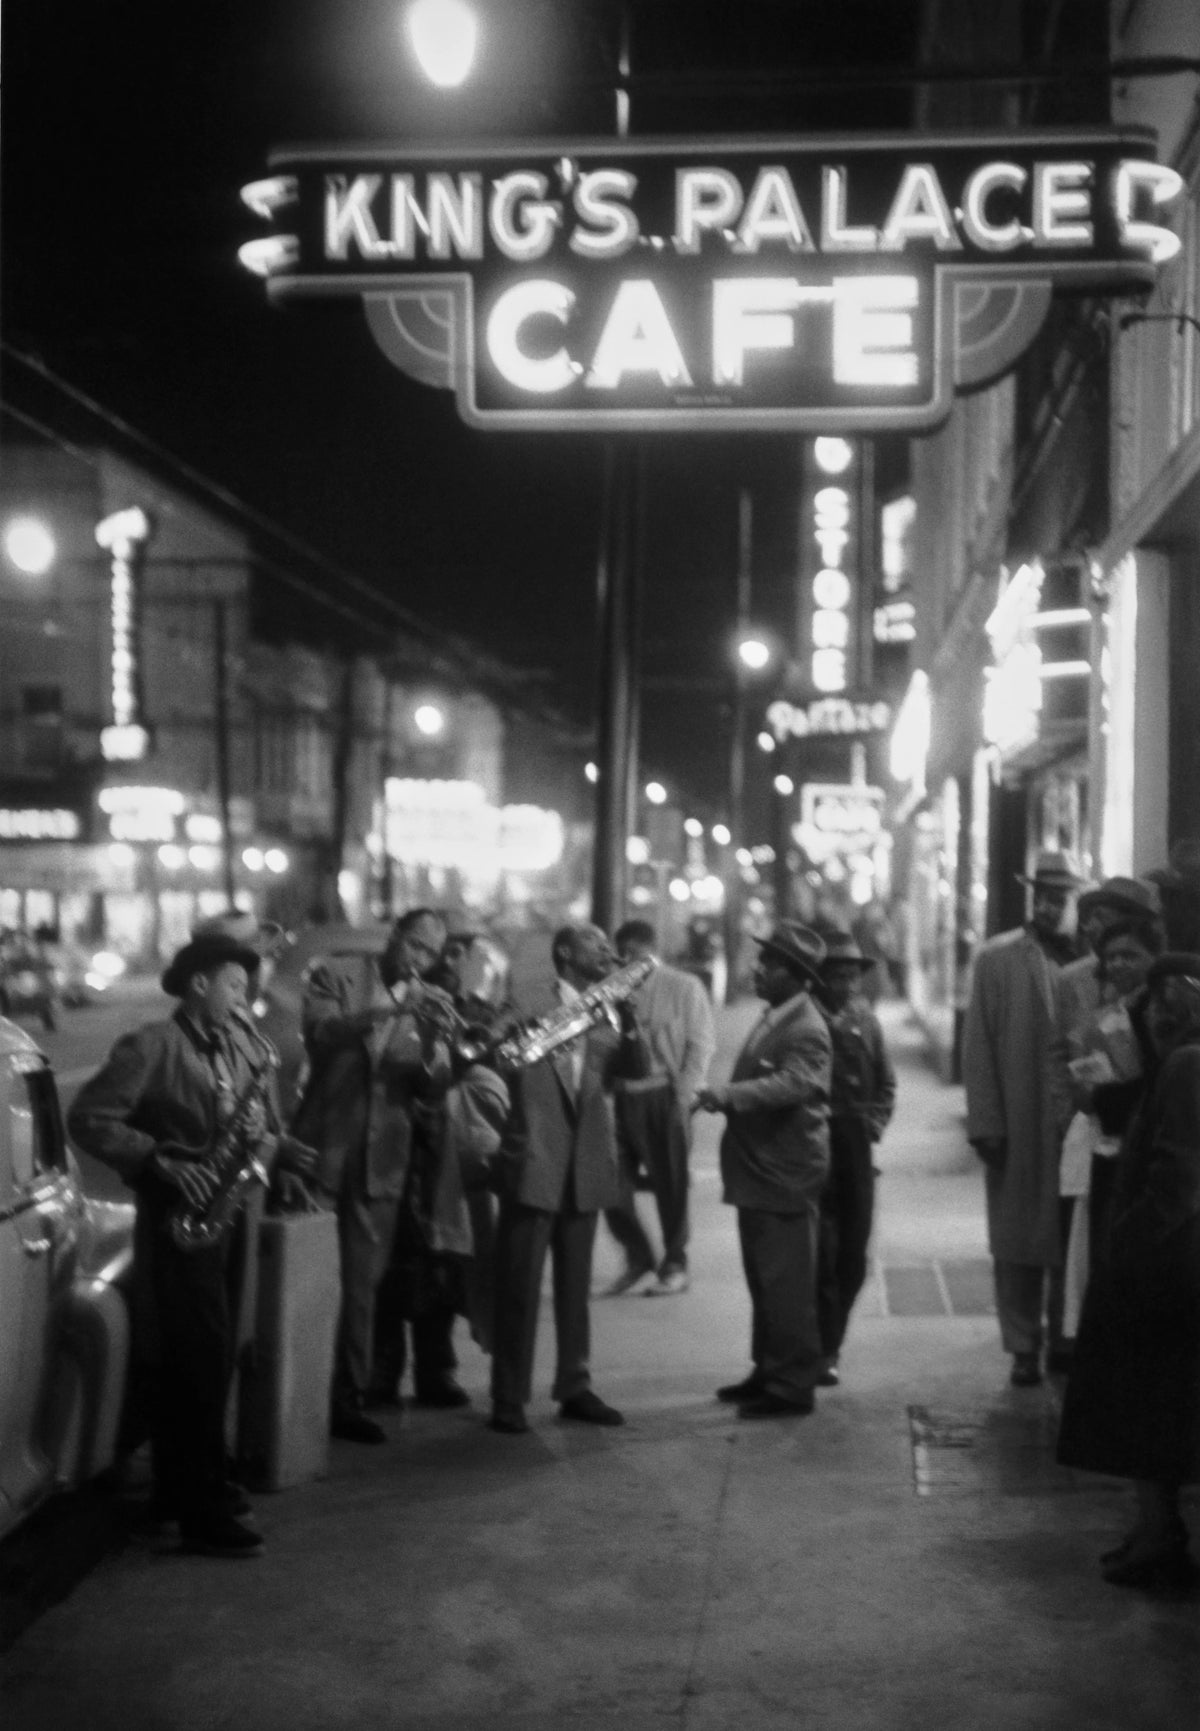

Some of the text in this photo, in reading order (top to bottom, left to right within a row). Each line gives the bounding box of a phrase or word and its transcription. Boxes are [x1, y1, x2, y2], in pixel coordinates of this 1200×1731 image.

[323, 157, 1096, 260] KING'S PALACE
[486, 275, 920, 392] CAFE
